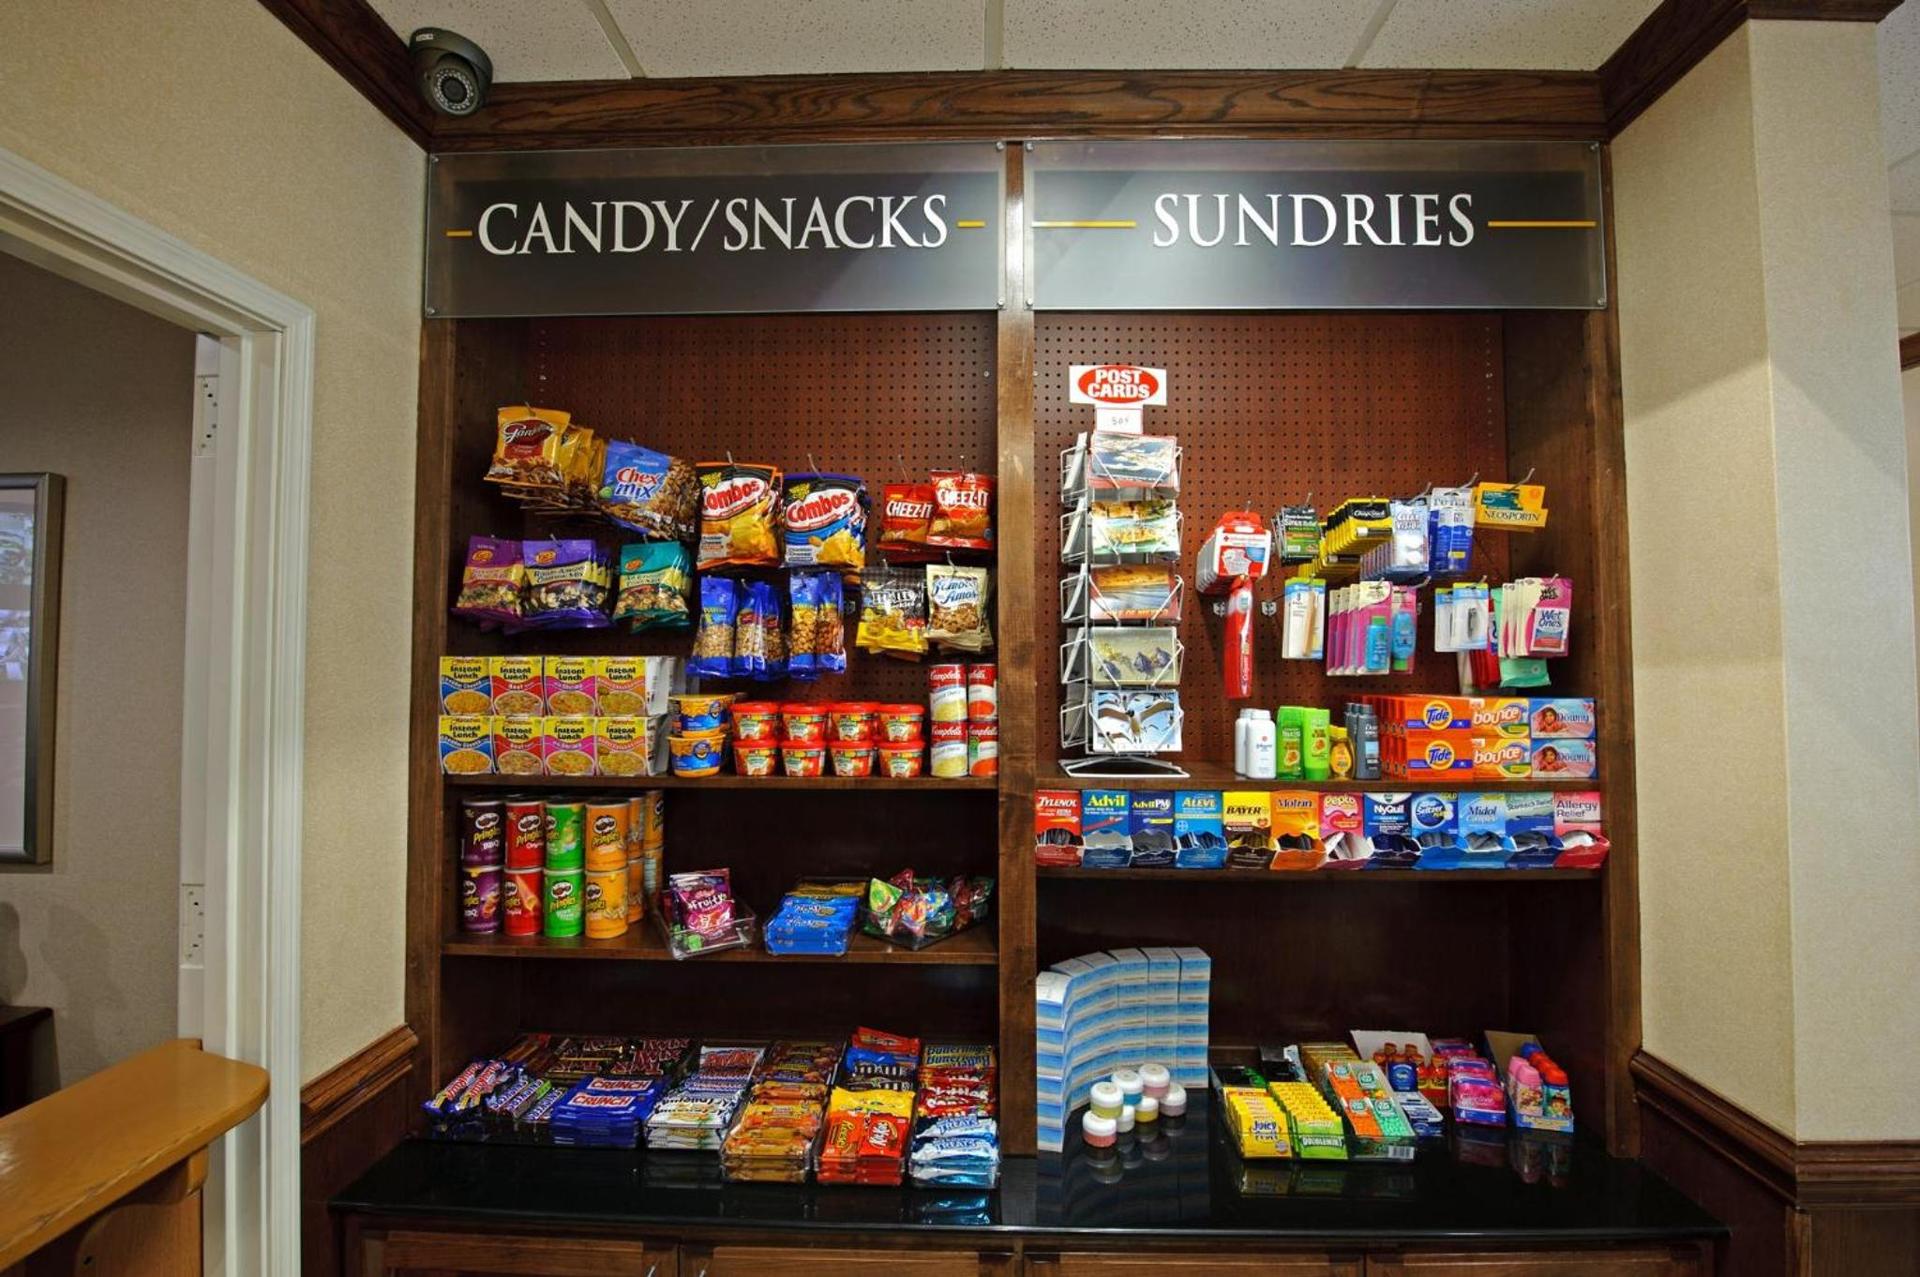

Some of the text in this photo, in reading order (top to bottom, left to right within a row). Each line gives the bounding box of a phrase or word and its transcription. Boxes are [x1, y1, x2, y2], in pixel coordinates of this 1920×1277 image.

[478, 194, 949, 256] CANDY/SNACKS
[1153, 193, 1475, 248] SUNDRIES
[1095, 368, 1143, 385] POST
[1087, 382, 1151, 399] CARDS
[617, 467, 658, 485] Chex
[786, 493, 851, 523] Combos
[1484, 510, 1541, 521] NEOSPORIN
[1541, 610, 1562, 620] Wet
[1538, 618, 1562, 629] Ones
[500, 666, 531, 674] Instant
[555, 666, 586, 675] Instant
[605, 666, 637, 674] Instant
[503, 672, 529, 680] Lunch
[558, 673, 583, 681] Lunch
[608, 672, 634, 680] Lunch
[1426, 707, 1451, 724] Tide
[1556, 712, 1590, 724] Downy
[1428, 749, 1453, 765] Tide
[1557, 752, 1591, 764] Downy
[1038, 796, 1078, 808] TYLENOL
[1087, 794, 1126, 807] Advil
[1182, 797, 1217, 809] ALEVE
[1557, 800, 1598, 811] Allergy
[1226, 805, 1262, 815] BAYER
[1373, 804, 1405, 815] NyQuil
[1469, 805, 1498, 816] Midol
[1557, 809, 1586, 817] Relief
[591, 1079, 648, 1091] CRUNCH
[572, 1094, 631, 1107] CRUNCH
[1253, 1120, 1277, 1131] Juicy
